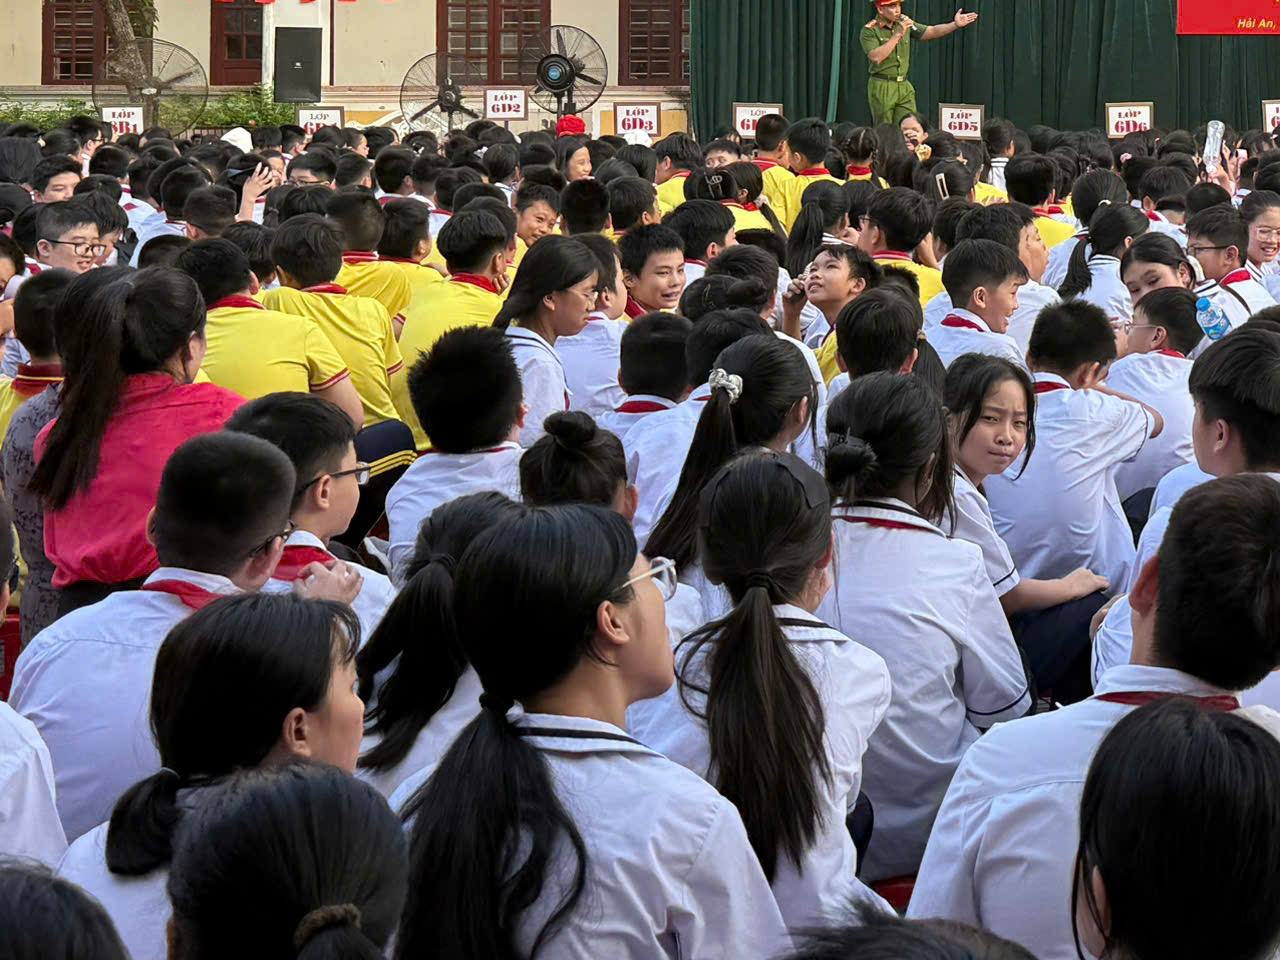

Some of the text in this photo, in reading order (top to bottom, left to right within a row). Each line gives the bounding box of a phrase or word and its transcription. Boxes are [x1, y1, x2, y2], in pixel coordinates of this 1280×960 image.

[1238, 17, 1256, 28] Hải
[1258, 19, 1276, 29] An,
[494, 92, 517, 102] LỚP
[491, 104, 521, 113] 6D2
[626, 106, 649, 116] LỚP
[112, 109, 135, 119] LỚP
[950, 110, 973, 119] LỚP
[621, 118, 653, 131] 6D3
[948, 121, 978, 131] 6D5
[1115, 120, 1147, 133] 6D6
